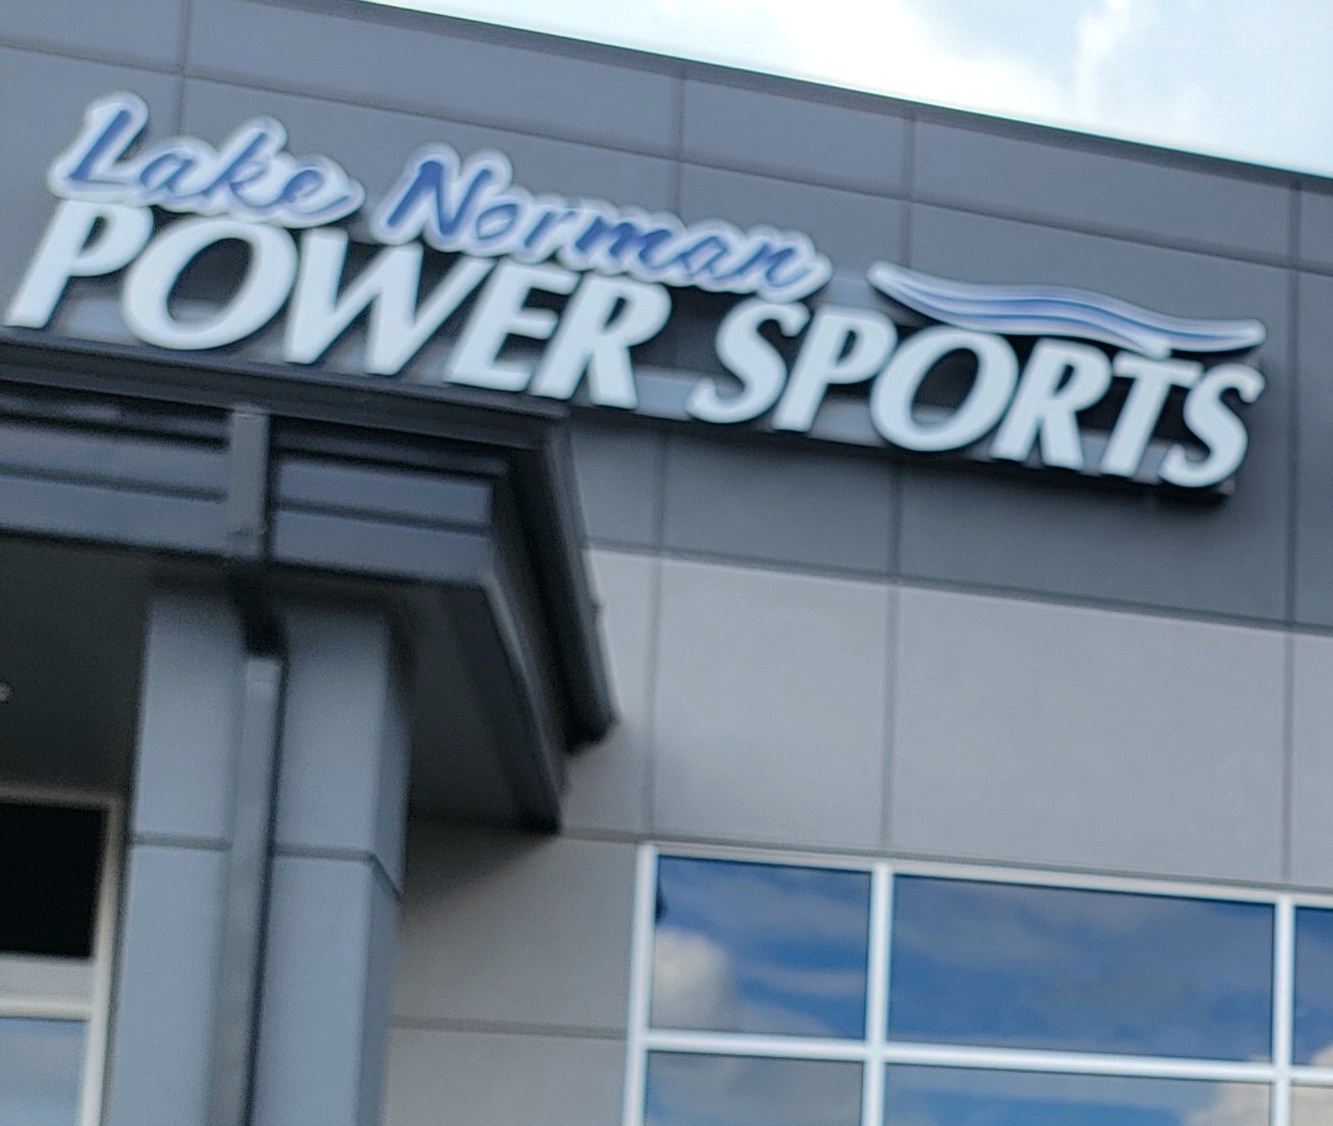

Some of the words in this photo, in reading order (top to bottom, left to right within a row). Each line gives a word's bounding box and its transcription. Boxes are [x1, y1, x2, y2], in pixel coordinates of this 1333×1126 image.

[50, 92, 364, 228] Lake
[370, 143, 832, 302] Norman
[3, 202, 672, 410] POWER
[686, 297, 1265, 489] SPORTS
